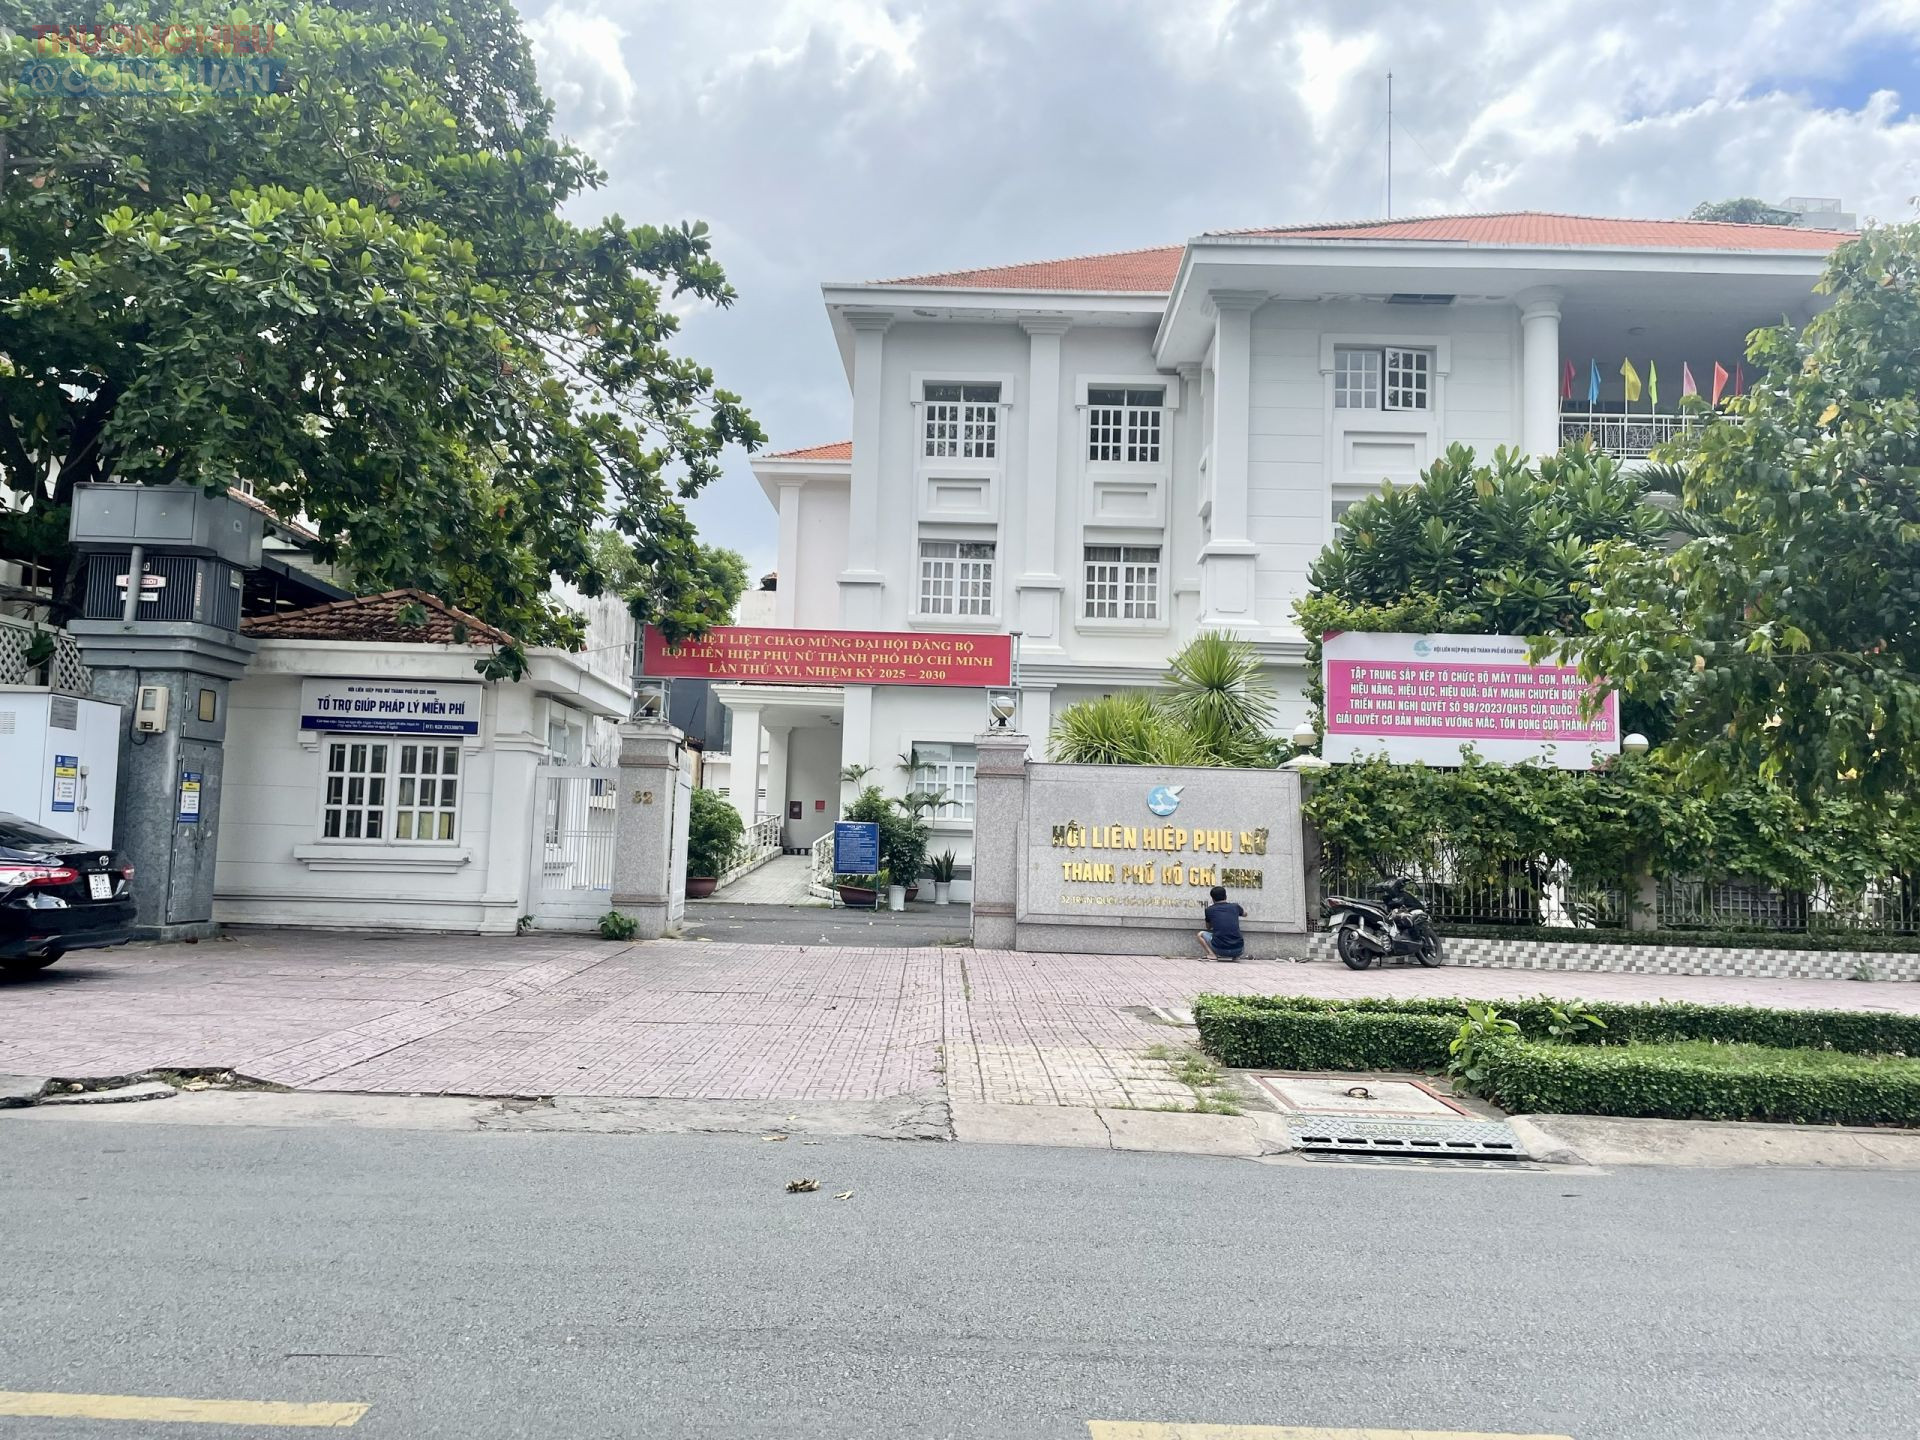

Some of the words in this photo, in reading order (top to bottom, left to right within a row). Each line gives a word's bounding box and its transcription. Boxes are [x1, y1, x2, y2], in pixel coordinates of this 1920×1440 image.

[730, 633, 761, 646] LIỆT
[764, 634, 805, 647] CHÀO
[808, 635, 851, 648] MỪNG
[855, 638, 879, 650] ĐẠI
[883, 638, 908, 650] HỘI
[912, 639, 951, 651] ĐẢNG
[955, 640, 974, 653] BỘ
[691, 646, 724, 658] LIÊN
[728, 648, 761, 660] HIỆP
[763, 650, 791, 663] PHỤ
[795, 649, 816, 662] NỮ
[819, 649, 867, 662] THÀNH
[871, 652, 899, 664] PHỐ
[903, 653, 923, 664] HỒ
[927, 653, 951, 666] CHÍ
[956, 657, 993, 667] MINH
[709, 661, 737, 673] LẦN
[740, 663, 771, 674] THỨ
[774, 665, 802, 676] XVI,
[805, 666, 852, 679] NHIỆM
[879, 669, 906, 679] 2025
[919, 670, 946, 680] 2030
[1351, 666, 1367, 681] TẬP
[1370, 669, 1397, 680] TRUNG
[1400, 667, 1416, 681] SẮP
[1419, 669, 1435, 682] XẾP
[1451, 670, 1475, 683] CHỨC
[1478, 671, 1488, 684] BỘ
[1492, 671, 1510, 684] MÁY
[1350, 682, 1368, 697] HIỆU
[1398, 683, 1416, 698] HIỆU
[1440, 684, 1458, 699] HIỆU
[1500, 688, 1526, 701] MẠNH
[332, 698, 353, 713] TRỢ
[354, 697, 377, 712] GIÚP
[379, 698, 405, 713] PHÁP
[407, 698, 420, 713] LÝ
[422, 698, 446, 714] MIỄN
[449, 700, 466, 715] PHÍ
[1376, 699, 1396, 710] KHAI
[1398, 700, 1418, 713] NGHỊ
[1421, 699, 1446, 713] QUYẾT
[1449, 700, 1460, 712] SỐ
[1463, 702, 1528, 715] 98/2023/QH15
[1530, 700, 1547, 715] CỦA
[1550, 701, 1572, 716] QUỐC
[1336, 711, 1352, 724] GIẢI
[1354, 712, 1380, 725] QUYẾT
[1382, 714, 1393, 725] CƠ
[1395, 712, 1412, 726] BẢN
[1414, 713, 1442, 727] NHỮNG
[1518, 719, 1540, 732] ĐỌNG
[1543, 717, 1559, 730] CỦA
[1052, 820, 1086, 853] HỘI
[1092, 822, 1137, 850] LIÊN
[1142, 823, 1188, 856] HIỆP
[1193, 829, 1233, 859] PHỤ
[1239, 826, 1269, 855] NỮ
[1062, 858, 1115, 883] THÀNH
[1122, 859, 1156, 885] PHỐ
[1161, 860, 1184, 886] HỒ
[1189, 863, 1217, 887] CHÍ
[1221, 868, 1263, 889] MINH
